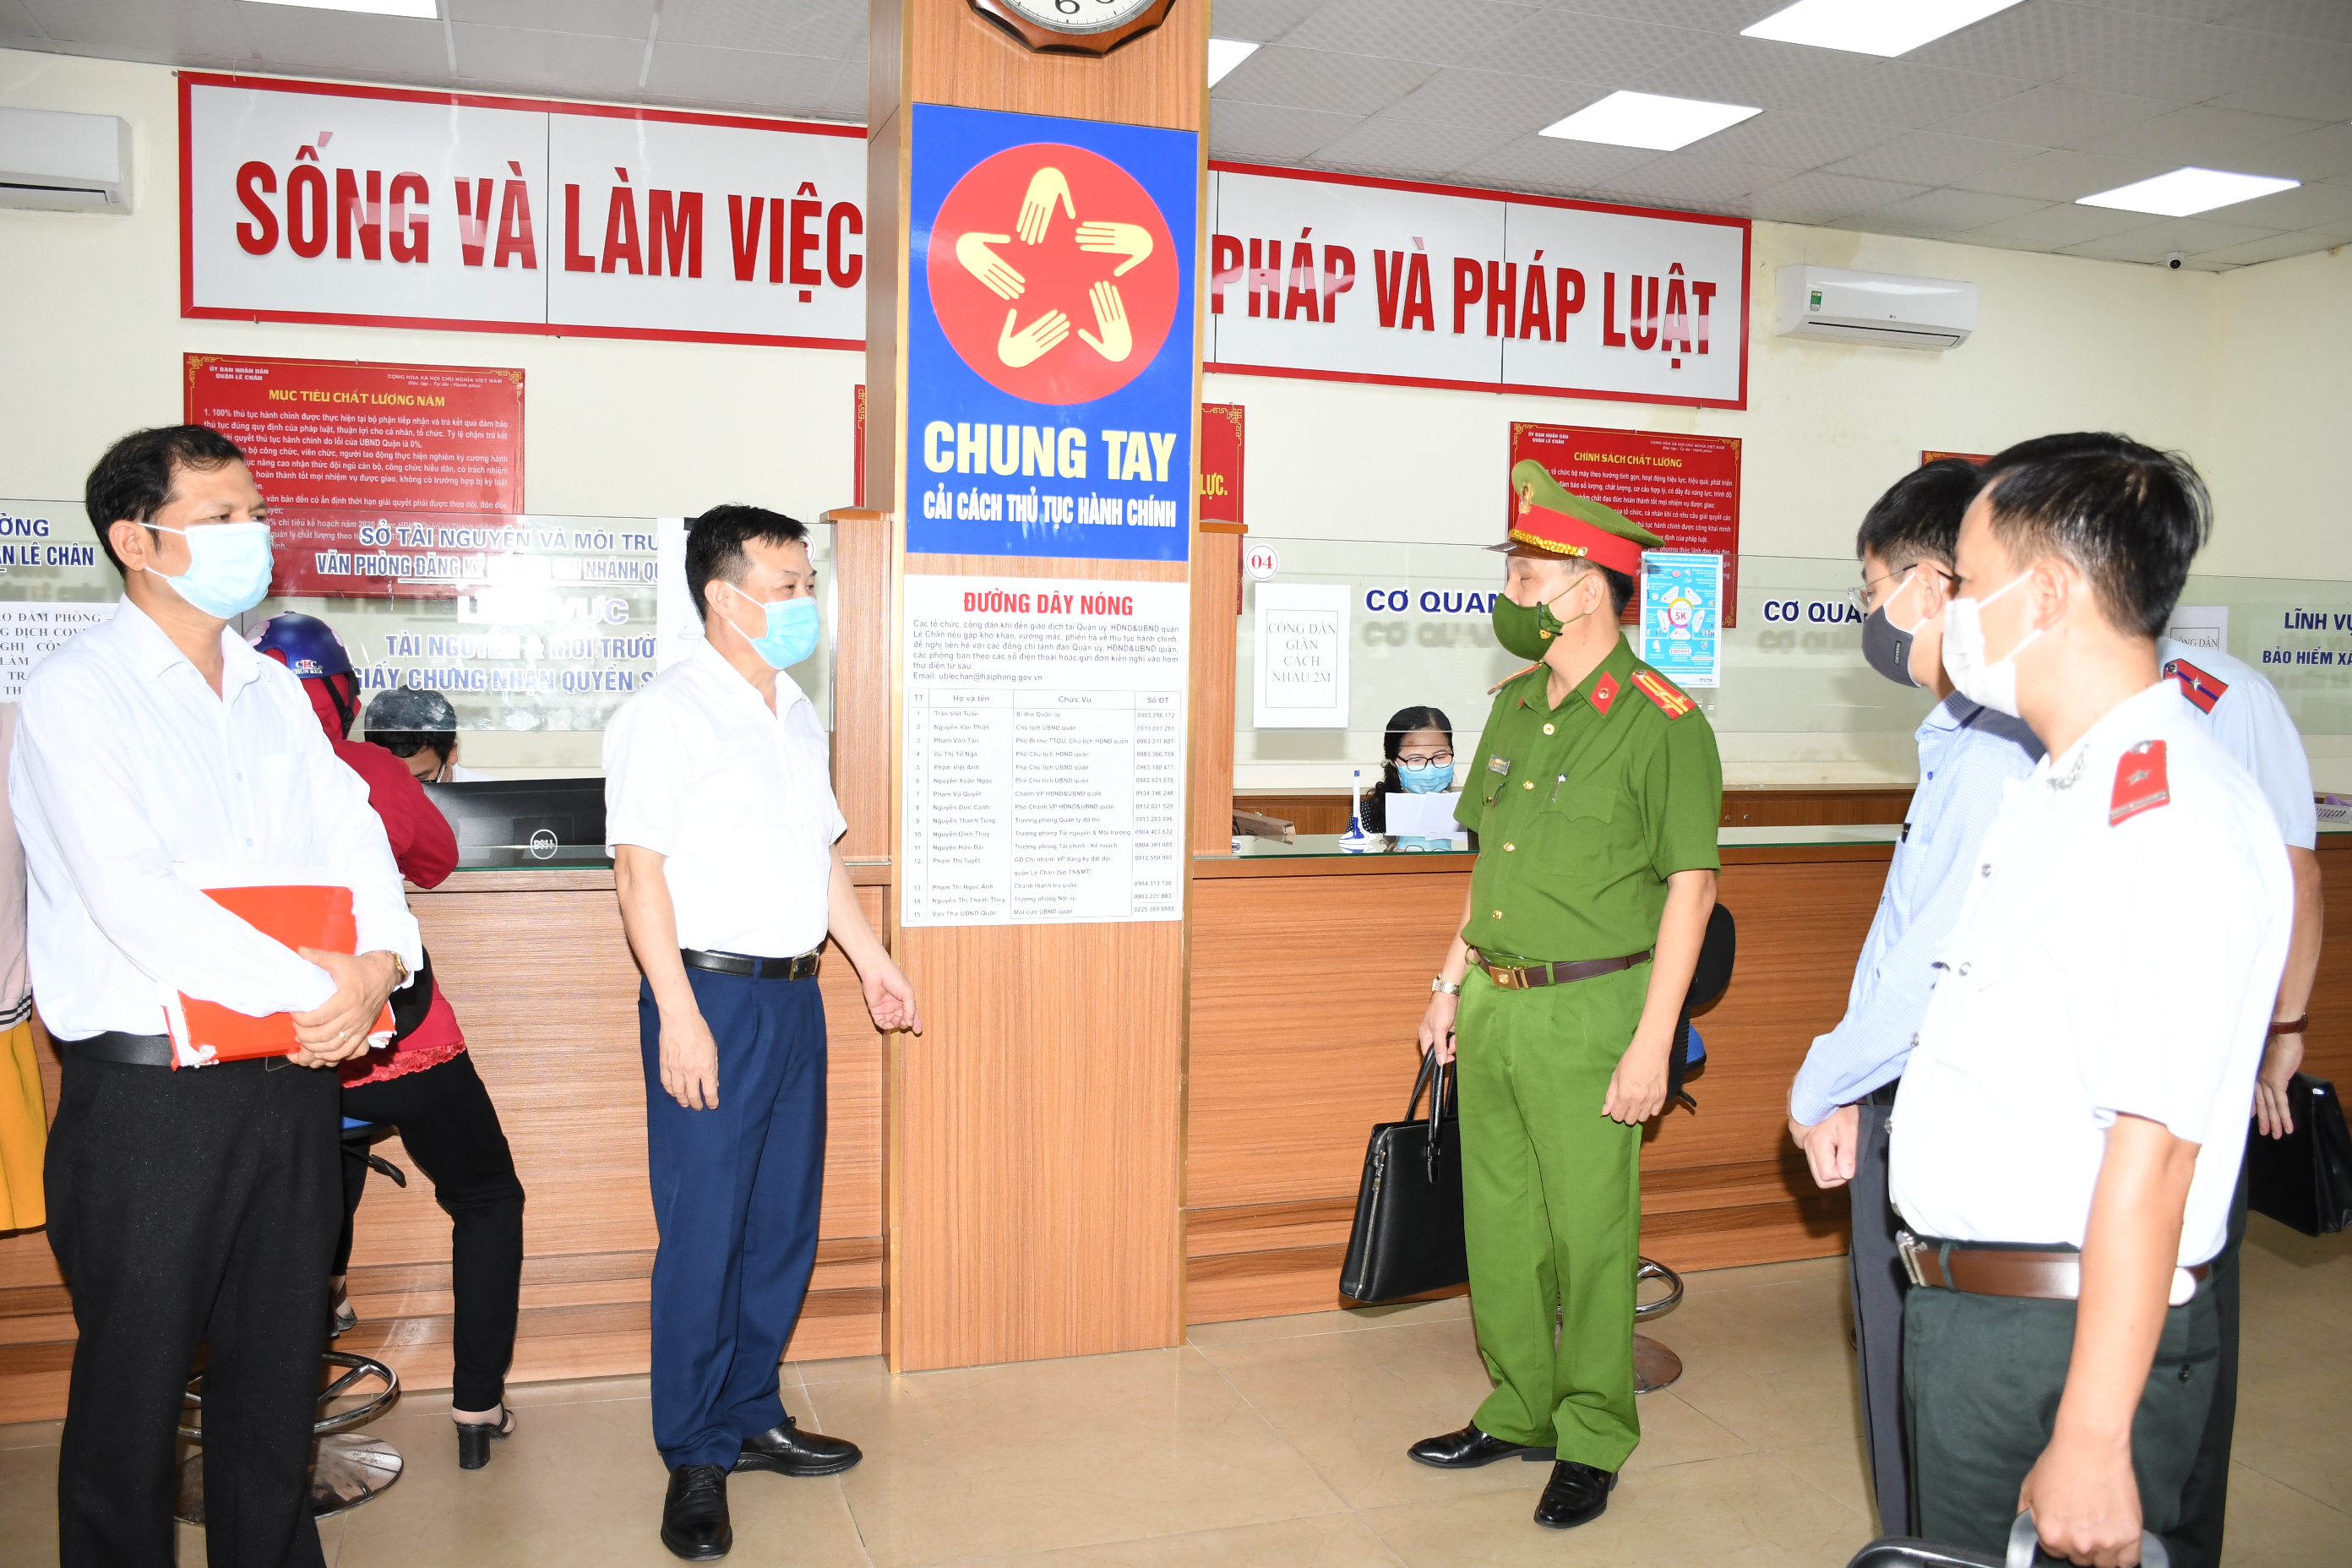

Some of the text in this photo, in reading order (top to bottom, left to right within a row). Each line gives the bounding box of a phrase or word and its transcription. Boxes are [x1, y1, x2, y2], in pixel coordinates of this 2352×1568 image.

[235, 131, 1717, 370] SỐNG VÀ LÀM VIỆC PHÁP VÀ PHÁP LUẬT
[270, 389, 297, 403] MỤC
[300, 389, 330, 402] TIÊU
[333, 388, 368, 404] CHẤT
[372, 394, 415, 406] LƯỢNG
[213, 409, 231, 417] 100%
[248, 411, 259, 419] tục
[260, 411, 278, 419] hành
[302, 411, 320, 421] được
[323, 412, 339, 422] thực
[340, 413, 356, 422] hiện
[368, 415, 377, 423] bộ
[379, 416, 396, 426] phận
[398, 416, 411, 427] tiếp
[412, 417, 429, 427] nhận
[452, 417, 463, 426] kết
[923, 420, 1177, 483] CHUNG TAY
[1574, 450, 1682, 468] CHÍNH SÁCH CHẤT LƯỢNG
[923, 483, 1177, 530] CẢI CÁCH THỦ TỤC HÀNH CHÍNH
[361, 520, 391, 546] SỞ
[400, 525, 433, 547] TÀI
[440, 527, 530, 548] NGUYÊN
[541, 529, 567, 548] VÀ
[575, 530, 613, 550] MÔI
[21, 542, 95, 567] LÊ CHÂN
[1251, 555, 1273, 569] 04
[317, 551, 351, 574] VĂN
[357, 551, 410, 575] PHÒNG
[416, 551, 458, 575] ĐĂNG
[585, 557, 639, 580] NHÁNH
[964, 588, 1133, 616] ĐƯỜNG DÂY NÓNG
[1366, 589, 1409, 612] CƠ
[1764, 601, 1868, 623] CƠ QUA
[2284, 608, 2328, 630] LĨNH
[15, 628, 47, 639] DỊCH
[0, 642, 24, 653] GHỊ
[386, 631, 419, 656] TÀI
[601, 633, 657, 659] TRƯỜ
[1286, 638, 1318, 650] GIÃN
[296, 660, 317, 669] CKC
[1283, 653, 1319, 666] CÁCH
[2262, 645, 2292, 664] BẢO
[2296, 646, 2333, 665] HIỂM
[8, 672, 27, 680] TR
[563, 664, 634, 694] QUYỀN
[939, 672, 1042, 682] ublechan@haiphong.gov.vn
[1272, 672, 1331, 682] NHAU 2M
[534, 839, 554, 850] DELL
